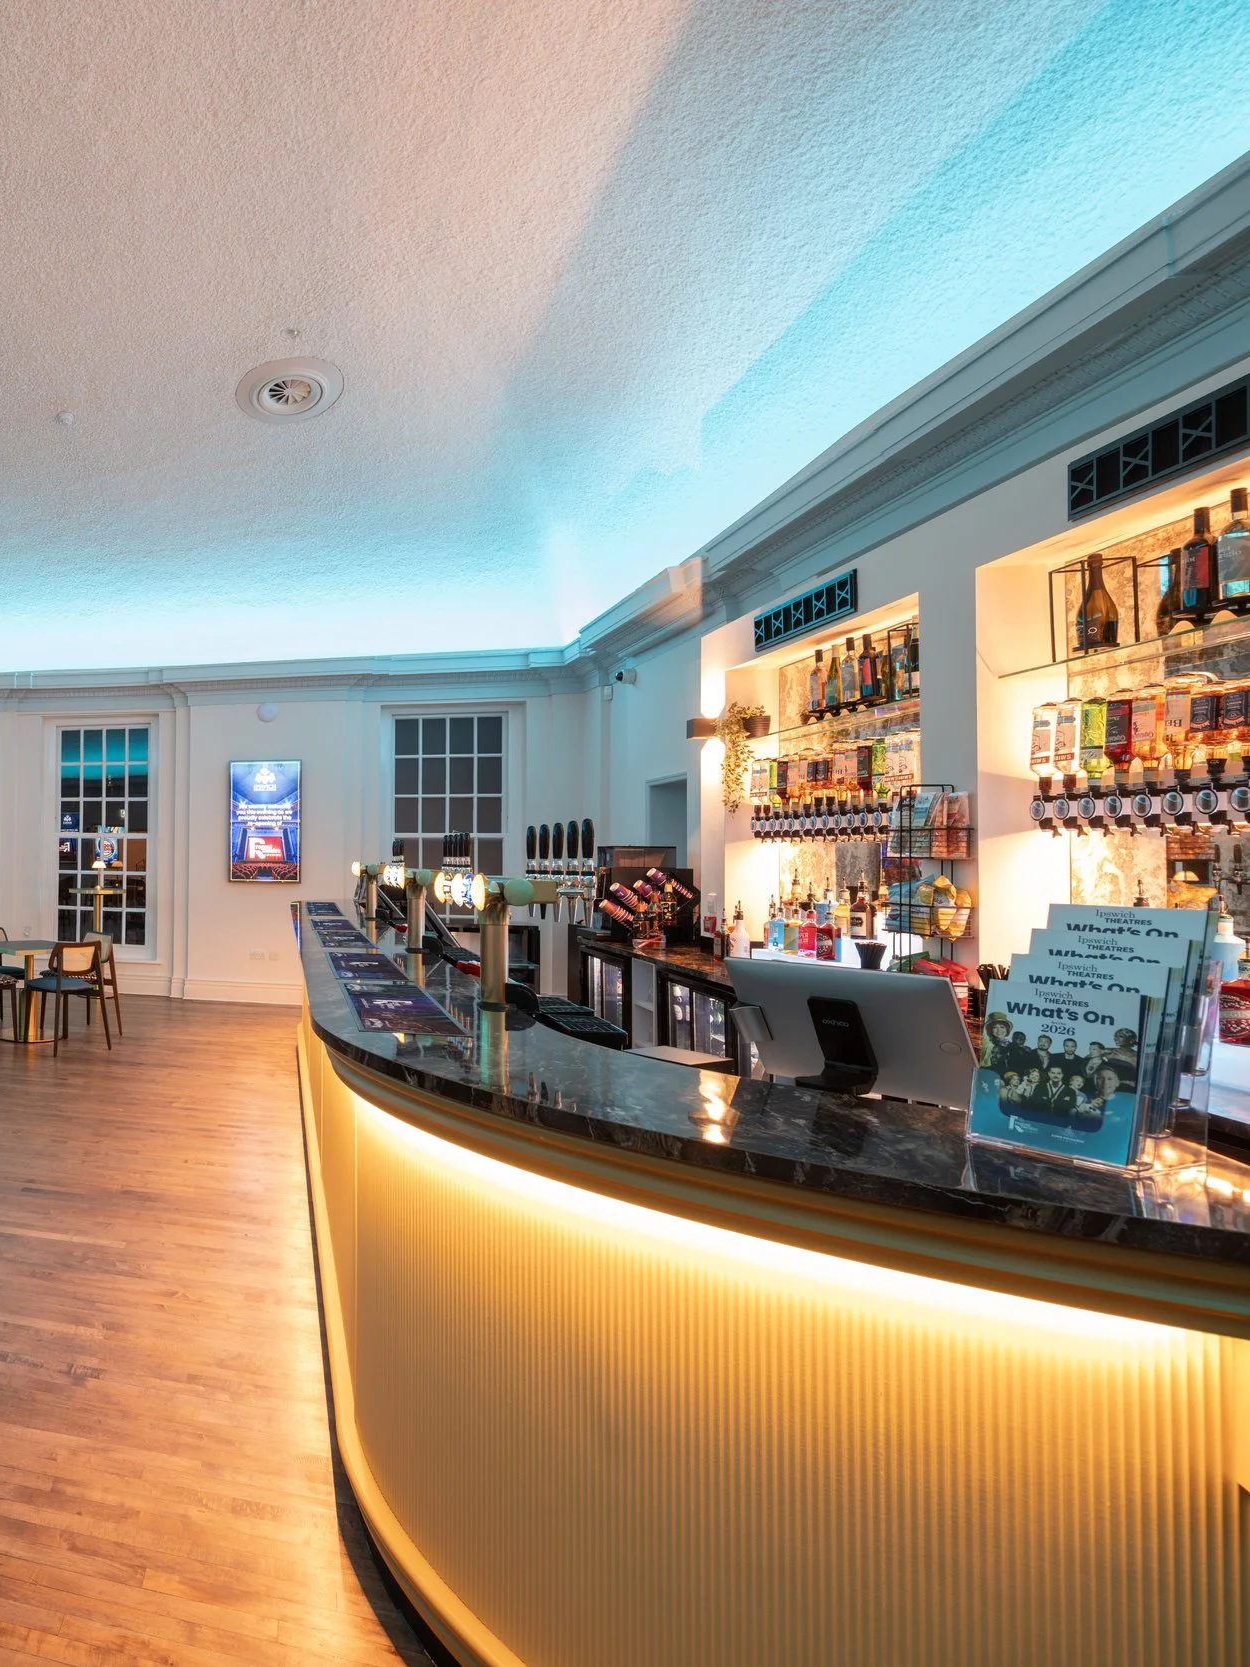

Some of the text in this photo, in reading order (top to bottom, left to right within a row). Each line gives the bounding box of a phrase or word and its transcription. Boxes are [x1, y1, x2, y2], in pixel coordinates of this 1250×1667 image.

[1096, 909, 1135, 918] Ipswich
[1067, 923, 1179, 938] What's On
[1078, 936, 1118, 945] Ipswich
[1087, 944, 1134, 953] THEATRES
[1058, 962, 1098, 972] Ipswich
[1067, 971, 1114, 980] THEATRES
[1029, 975, 1140, 993] What's On
[1035, 988, 1073, 999] Ipswich
[1044, 997, 1089, 1008] THEATRES
[1007, 1001, 1114, 1026] What's On
[1041, 1024, 1075, 1036] 2026
